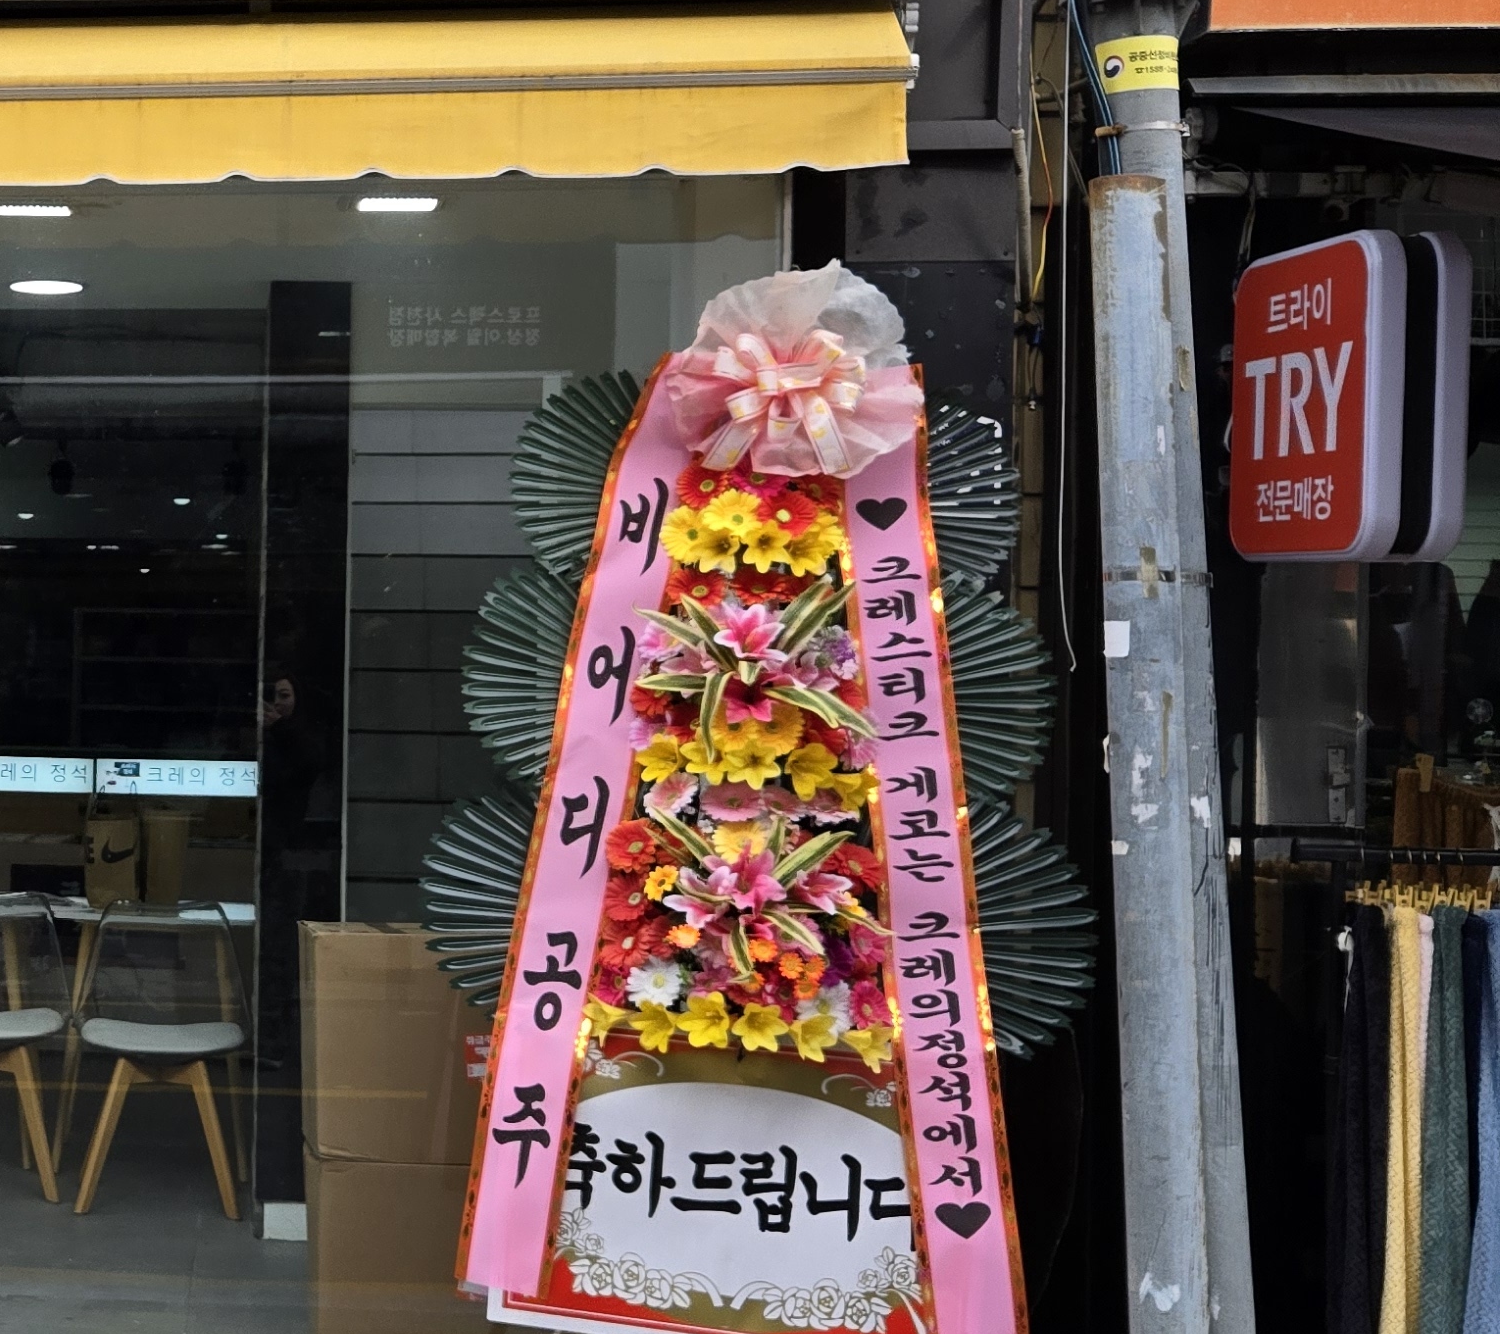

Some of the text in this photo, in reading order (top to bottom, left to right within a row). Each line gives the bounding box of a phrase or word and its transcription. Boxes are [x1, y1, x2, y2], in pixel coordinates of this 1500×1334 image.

[1266, 278, 1332, 334] 트라이
[1245, 341, 1354, 461] TRY
[1255, 475, 1334, 525] 전문매장
[50, 763, 88, 785] 정석
[146, 766, 206, 786] 크레의
[218, 766, 257, 787] 정석
[491, 476, 669, 1188] 비어디공주
[861, 555, 985, 1198] 크레스티크 게코는 크레의정석에서
